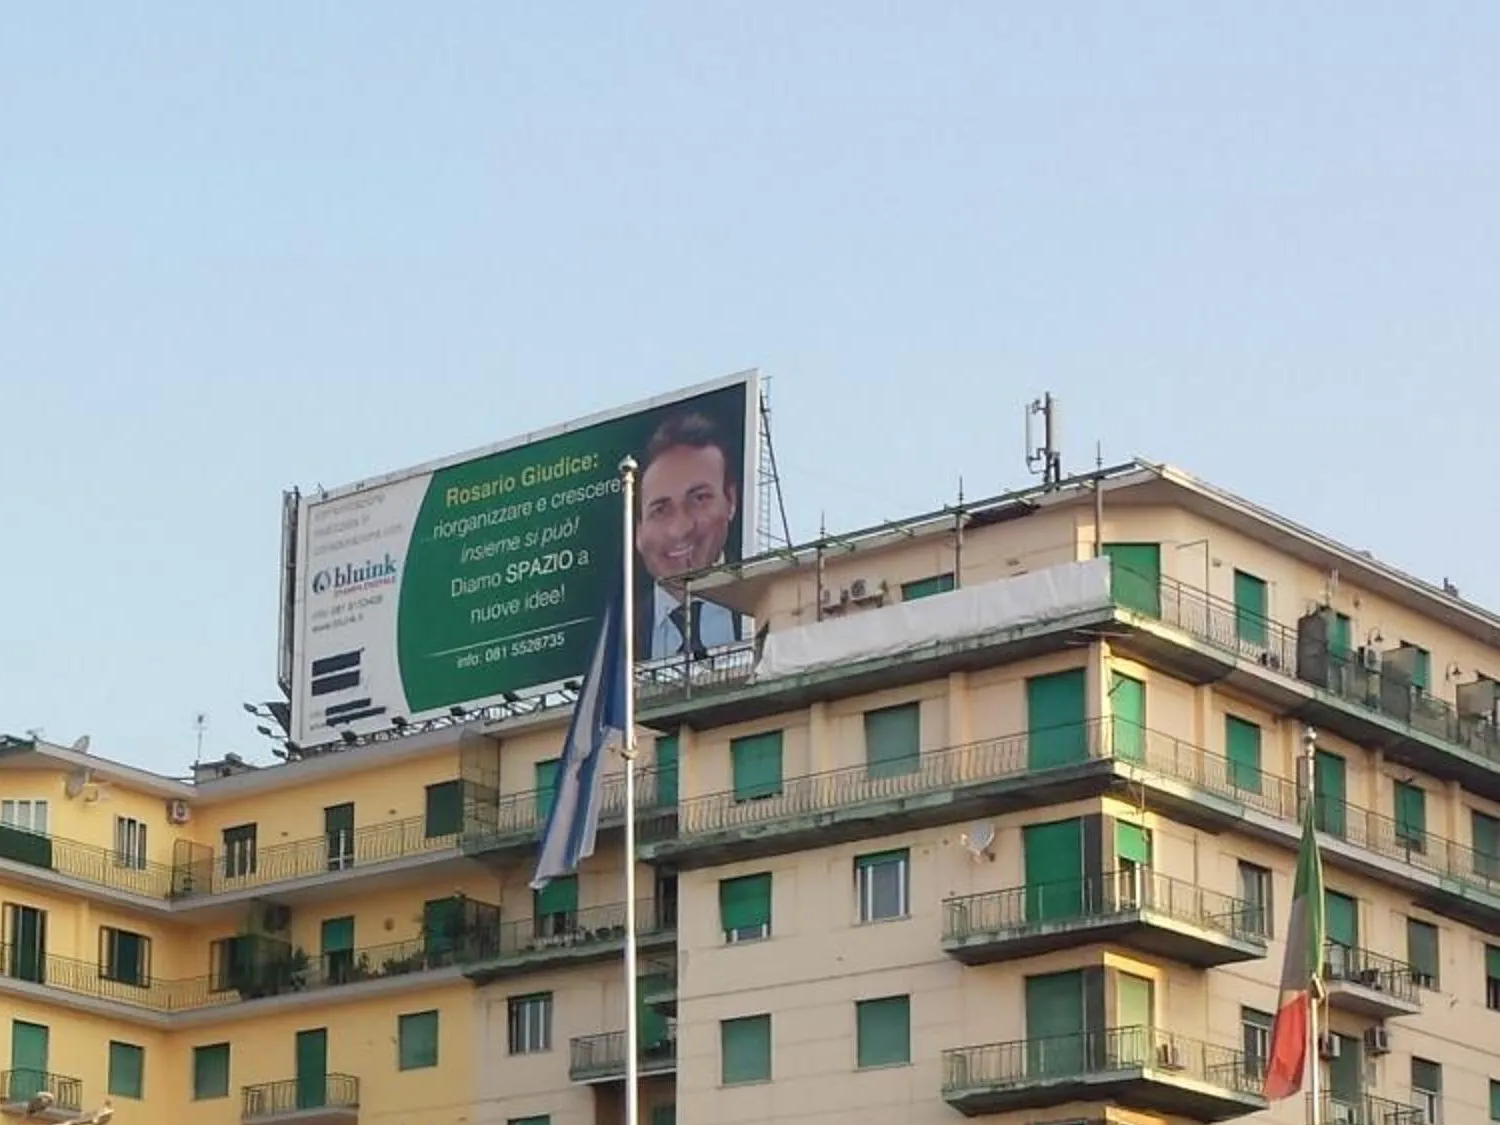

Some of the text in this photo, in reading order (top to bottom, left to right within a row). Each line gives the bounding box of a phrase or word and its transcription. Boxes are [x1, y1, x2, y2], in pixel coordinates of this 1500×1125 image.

[446, 452, 599, 508] Rosario Giudice:
[433, 500, 532, 539] riorganizzare
[537, 497, 547, 512] e
[525, 530, 538, 547] si
[334, 553, 396, 588] bluink
[451, 549, 589, 597] Diamo SPAZIO a
[470, 583, 566, 624] nuove idee!
[457, 653, 481, 668] info:
